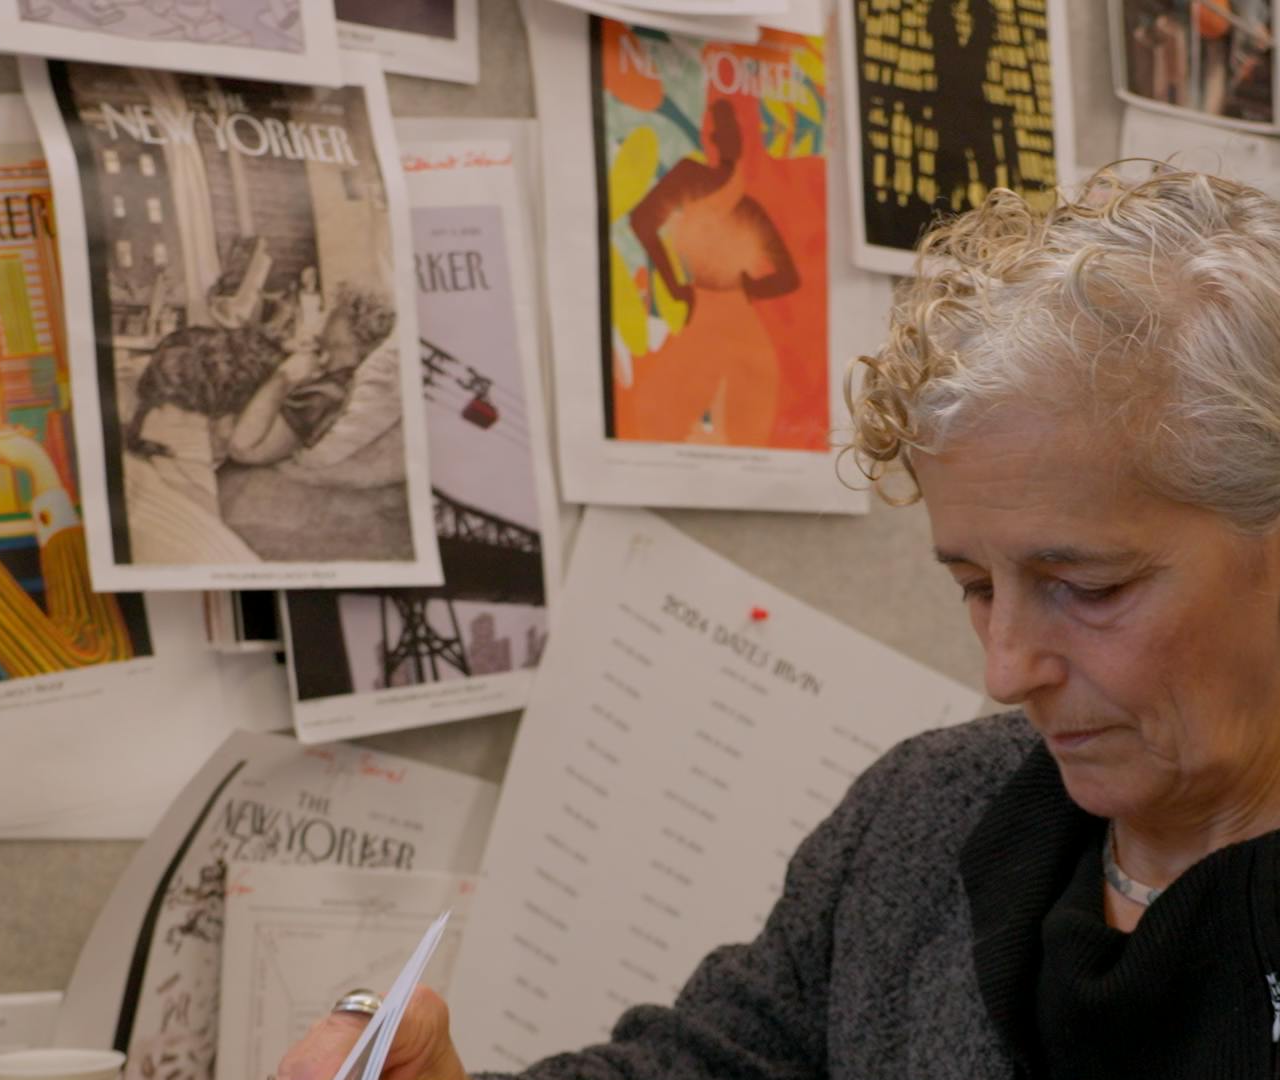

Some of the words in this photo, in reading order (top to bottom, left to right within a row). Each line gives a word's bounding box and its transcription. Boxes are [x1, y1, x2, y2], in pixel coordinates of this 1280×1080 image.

[98, 101, 198, 147] NEW
[199, 110, 360, 168] YORKER
[286, 810, 417, 872] YORKER
